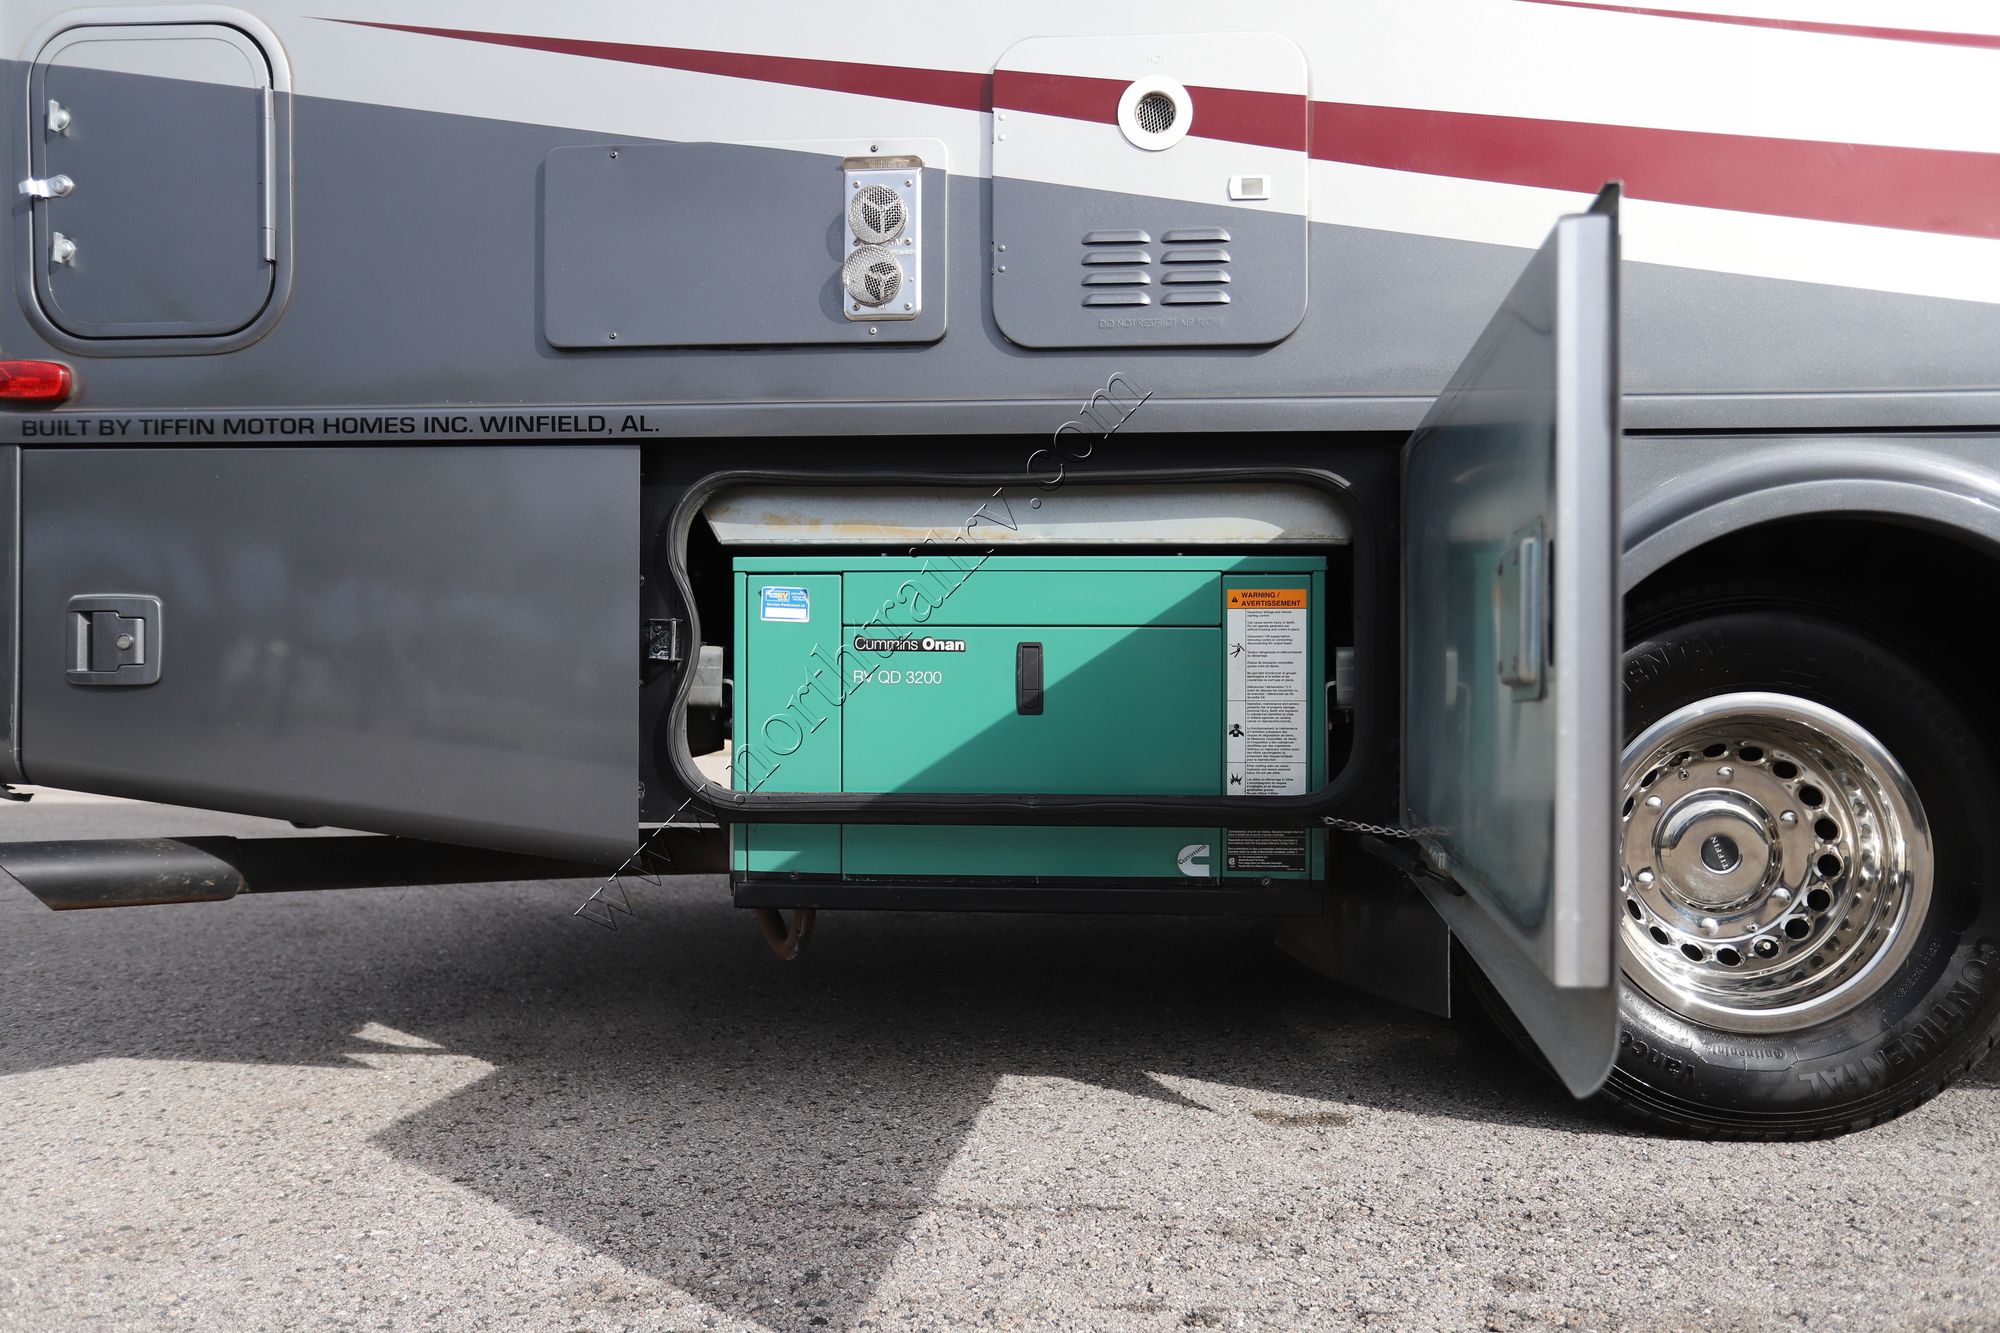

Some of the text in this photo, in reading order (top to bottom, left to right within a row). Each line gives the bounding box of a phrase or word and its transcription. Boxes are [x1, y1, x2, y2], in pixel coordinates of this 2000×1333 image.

[22, 416, 660, 437] BUILT BY TIFFIN MOTOR HOMES INC. WINFIELD, AL.
[854, 636, 965, 651] Cummins Onan
[853, 670, 942, 685] RV QD 3200
[1178, 844, 1207, 865] Cummins
[1711, 835, 1729, 870] TIFFIN
[1798, 936, 1998, 1098] CONTINENTAL
